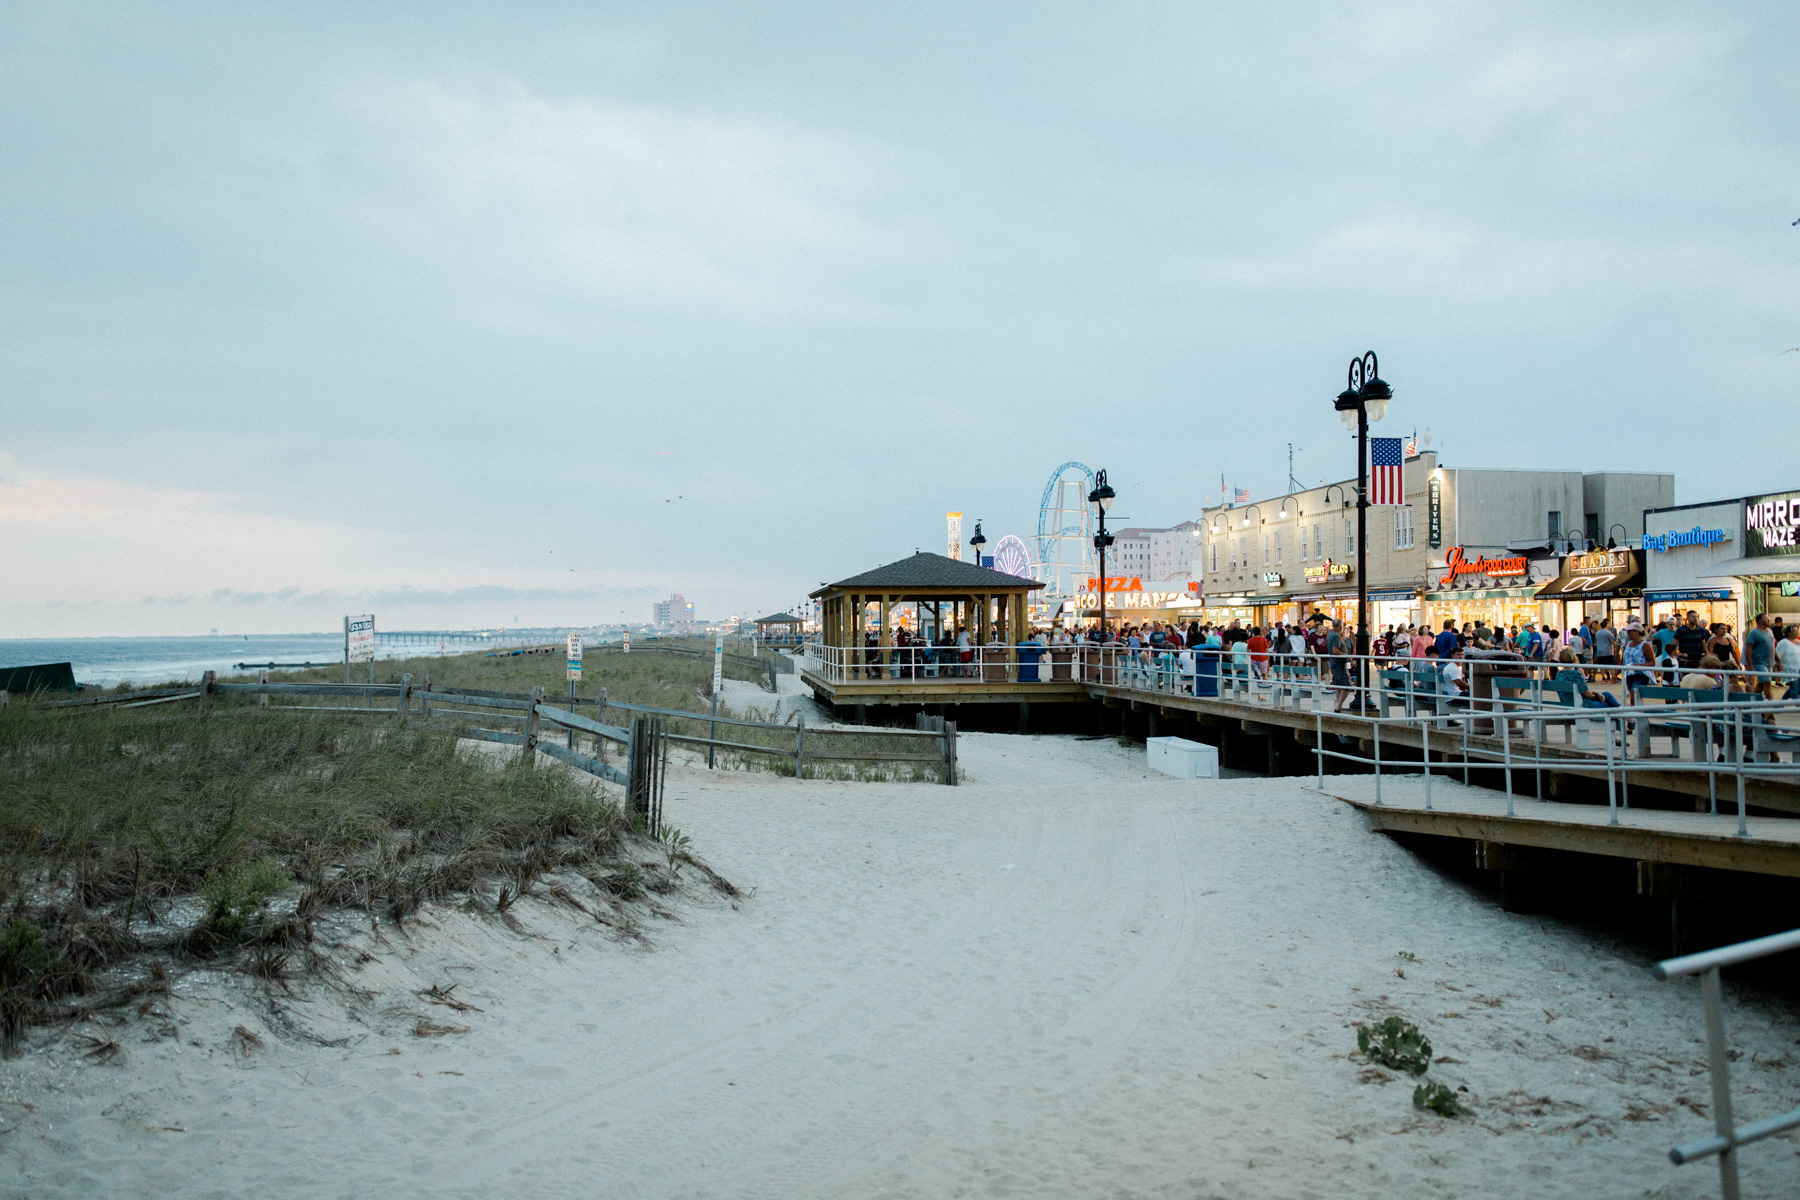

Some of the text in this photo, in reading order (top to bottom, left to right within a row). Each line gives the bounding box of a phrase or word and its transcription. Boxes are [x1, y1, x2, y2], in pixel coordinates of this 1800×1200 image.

[1643, 526, 1724, 554] Bag Boutique
[1763, 527, 1796, 548] MAZE
[1484, 559, 1502, 570] FOOD
[1503, 557, 1527, 569] COURT
[1572, 553, 1625, 570] SHADES
[1087, 577, 1143, 592] PIZZA
[1104, 592, 1116, 608] &
[1379, 645, 1386, 654] 9
